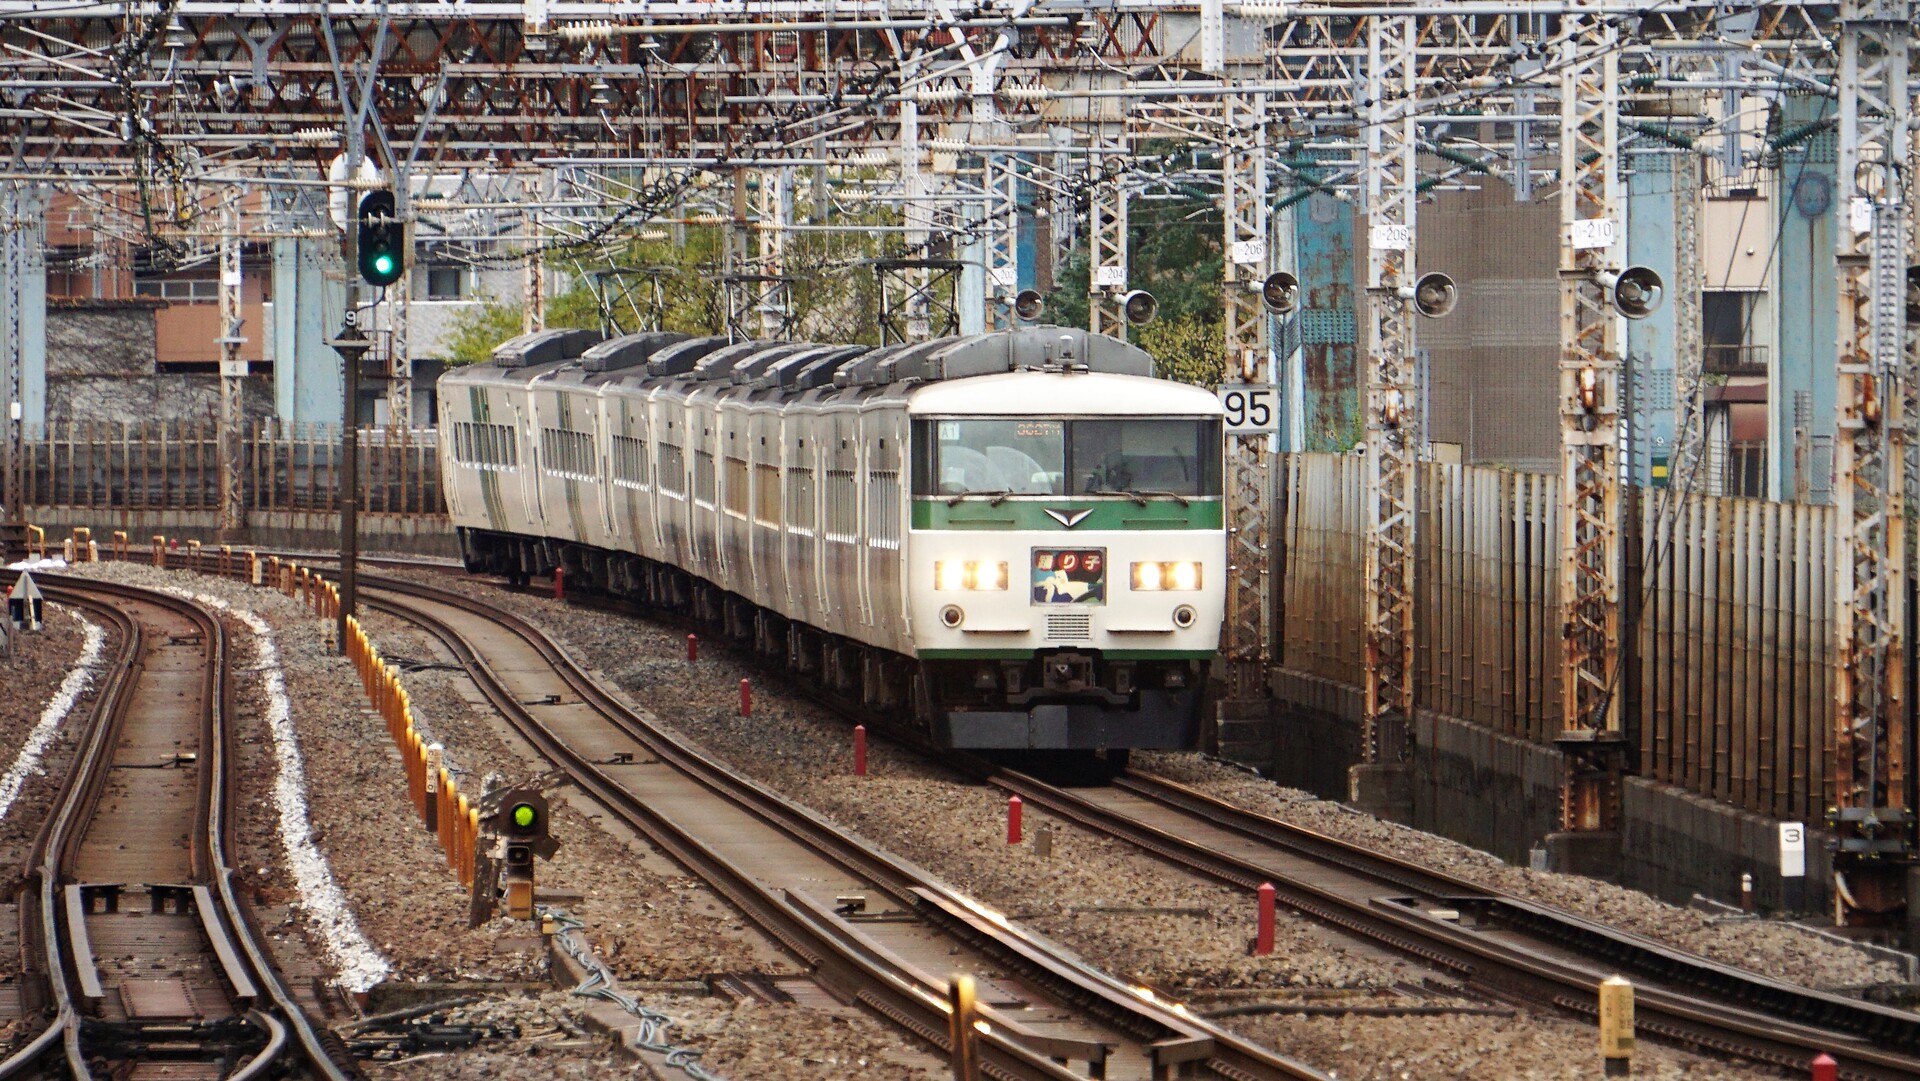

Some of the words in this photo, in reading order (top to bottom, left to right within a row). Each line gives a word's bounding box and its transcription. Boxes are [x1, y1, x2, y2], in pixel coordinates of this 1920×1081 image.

[345, 311, 357, 326] 9
[1225, 391, 1270, 426] 95
[1785, 829, 1800, 843] 3
